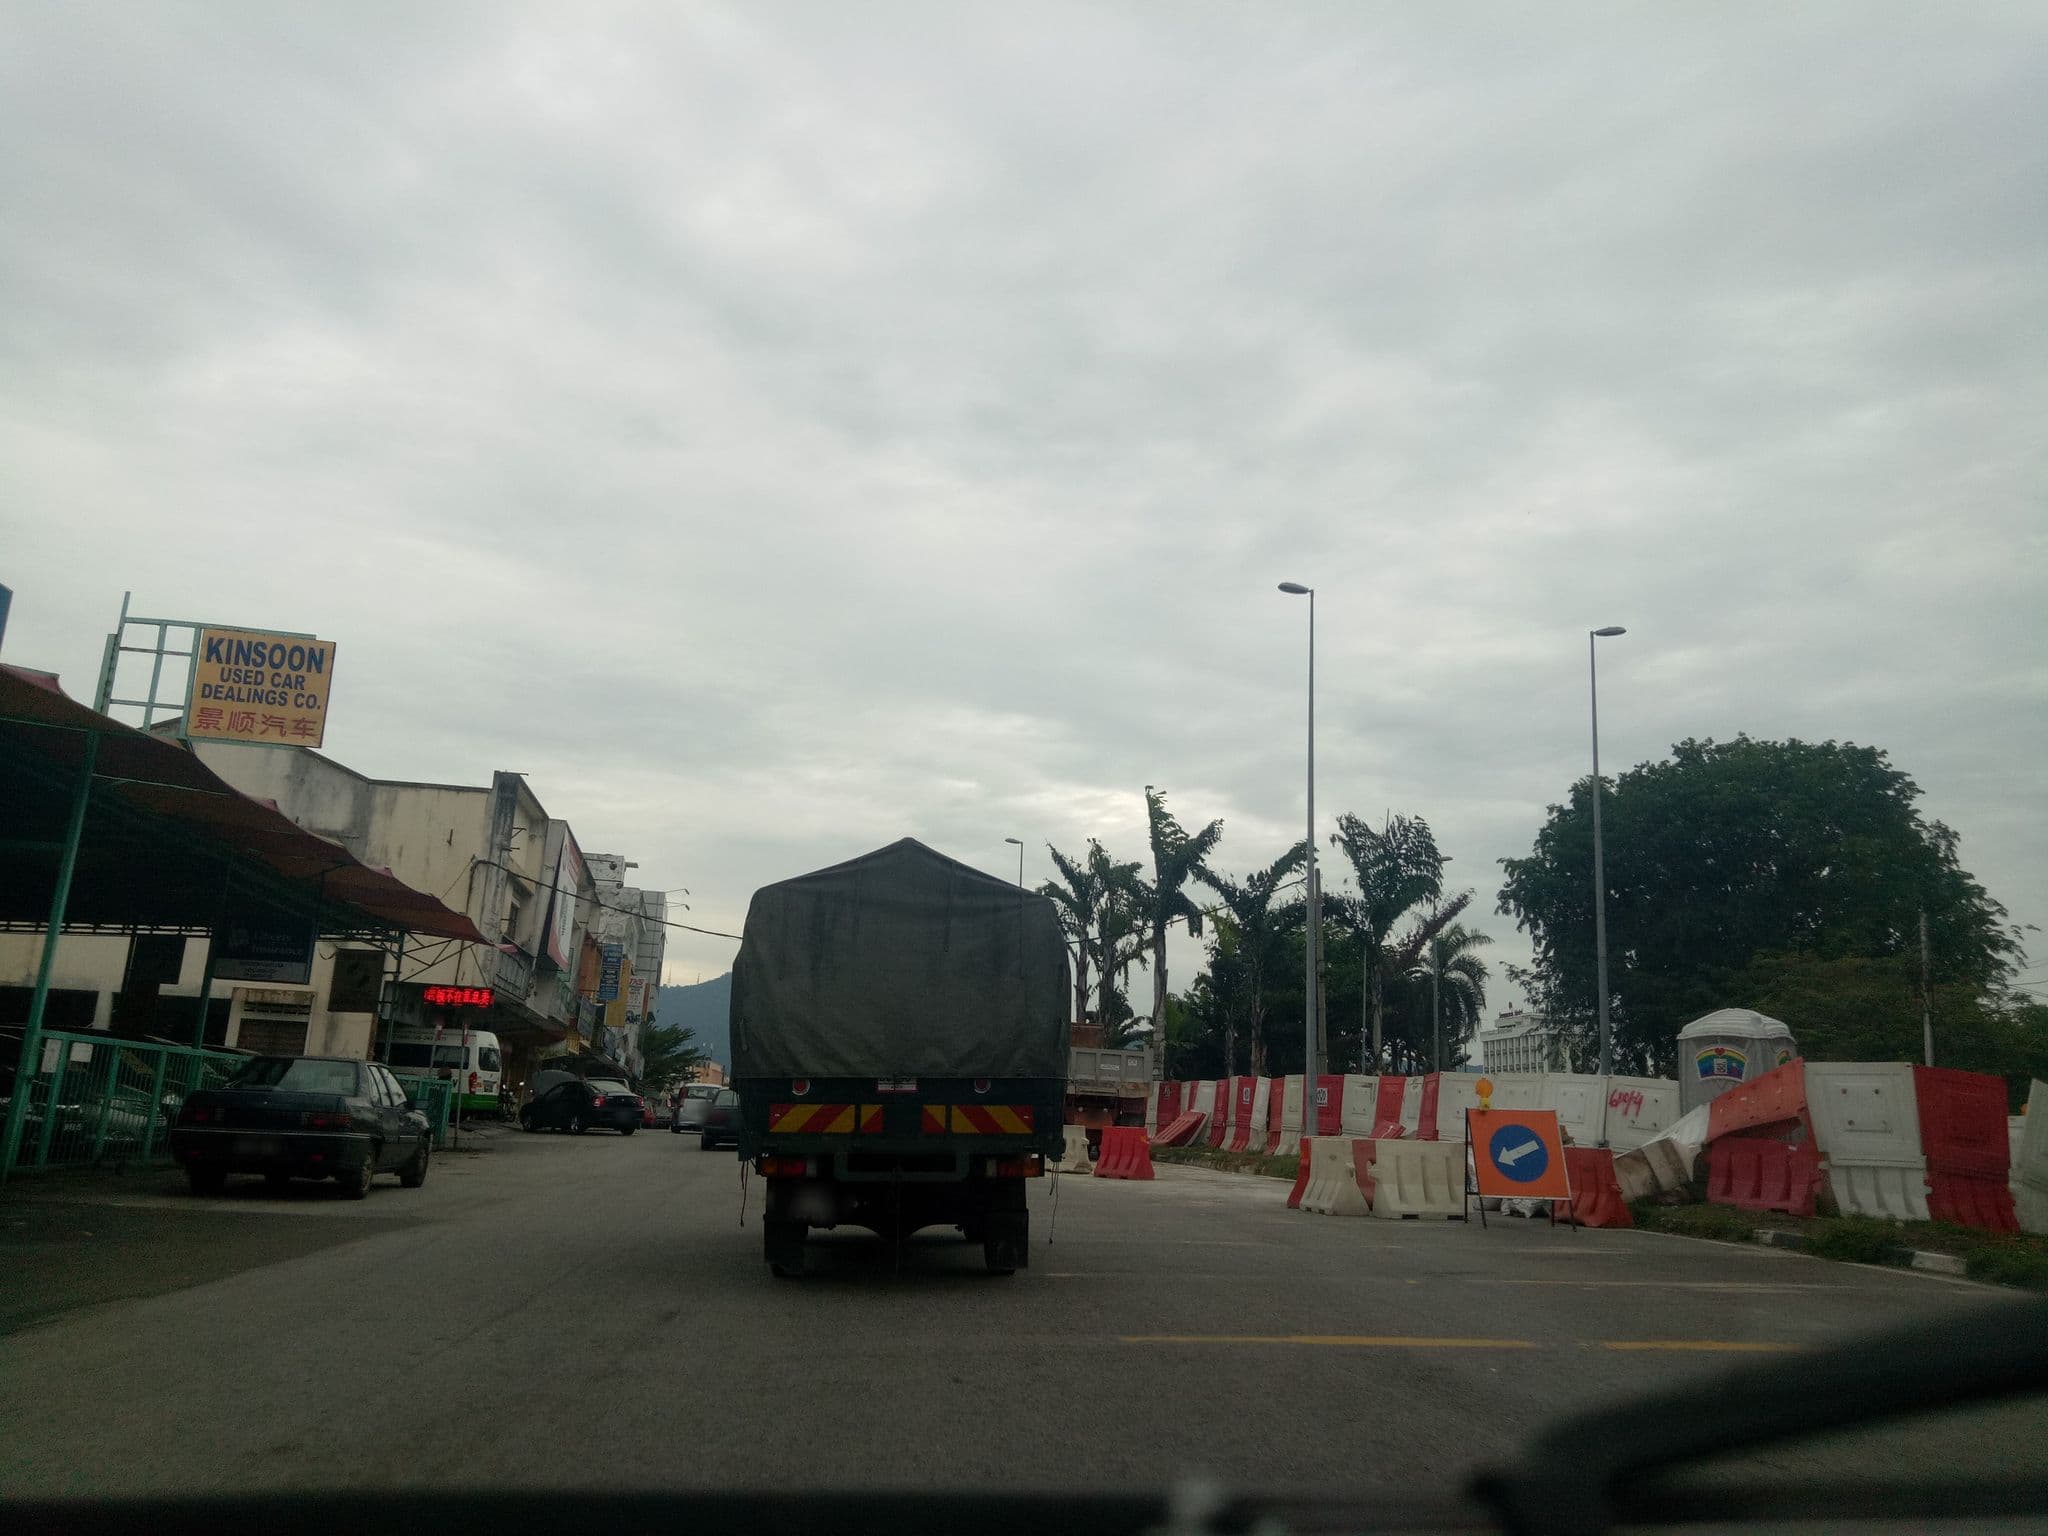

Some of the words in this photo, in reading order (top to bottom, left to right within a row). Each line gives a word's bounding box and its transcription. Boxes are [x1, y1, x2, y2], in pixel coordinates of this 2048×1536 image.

[206, 637, 324, 673] KINSOON
[220, 667, 265, 686] USED
[271, 672, 306, 690] CAR
[201, 683, 288, 707] DEALINGS
[294, 692, 321, 710] CO.
[194, 707, 319, 739] 景顺汽车
